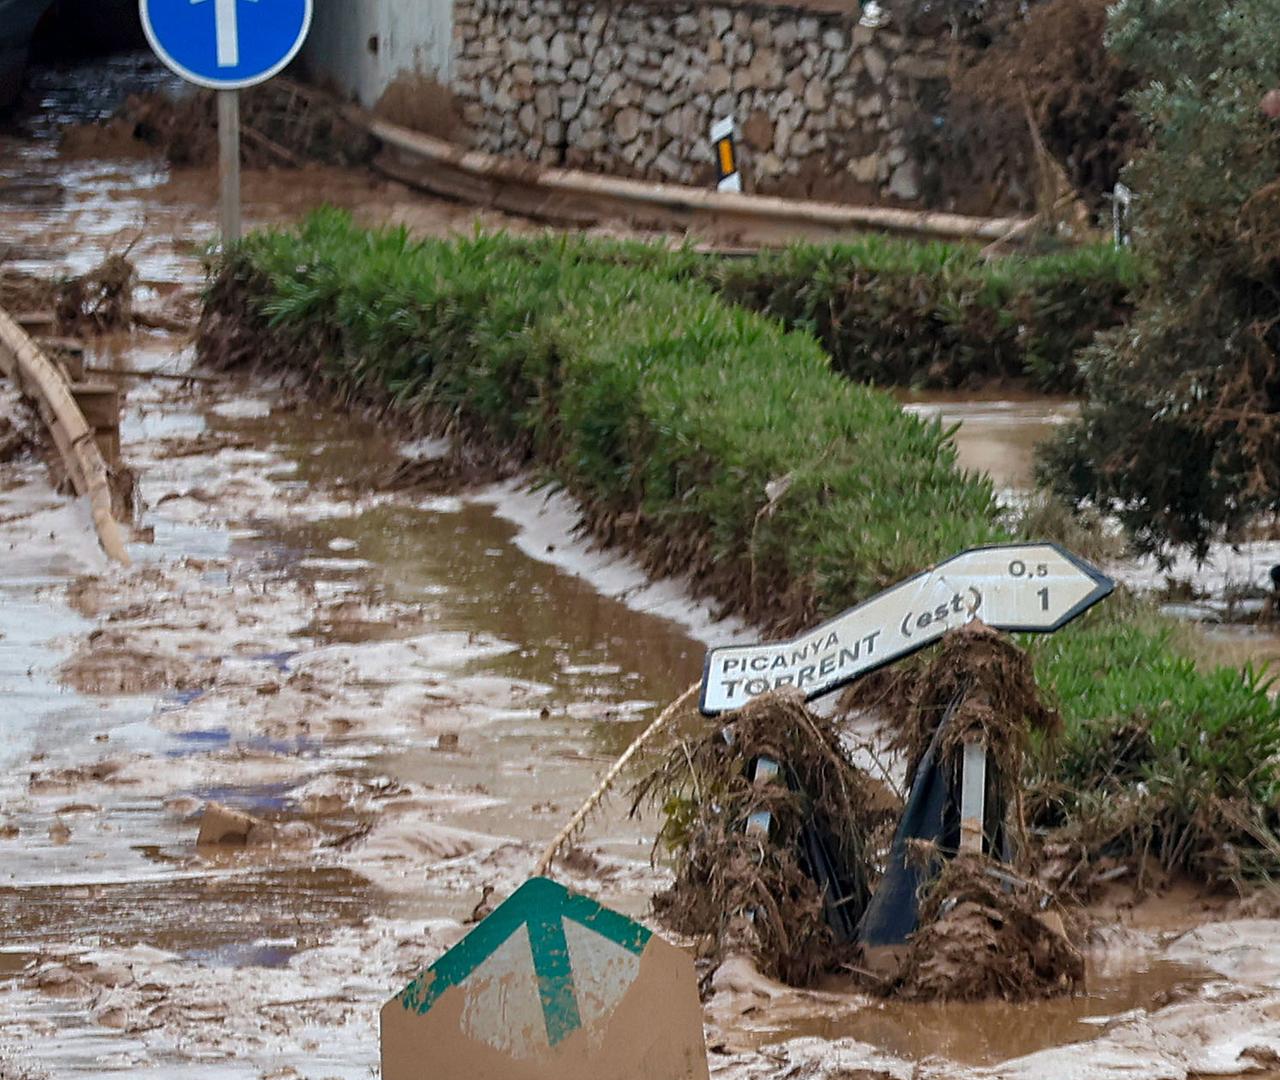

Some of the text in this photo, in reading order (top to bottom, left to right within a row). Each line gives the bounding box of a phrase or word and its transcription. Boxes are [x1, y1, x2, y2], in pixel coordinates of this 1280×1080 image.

[721, 586, 982, 699] TORRENT (est)
[722, 560, 1048, 674] PICANYA 0,5
[1037, 587, 1049, 611] 1
